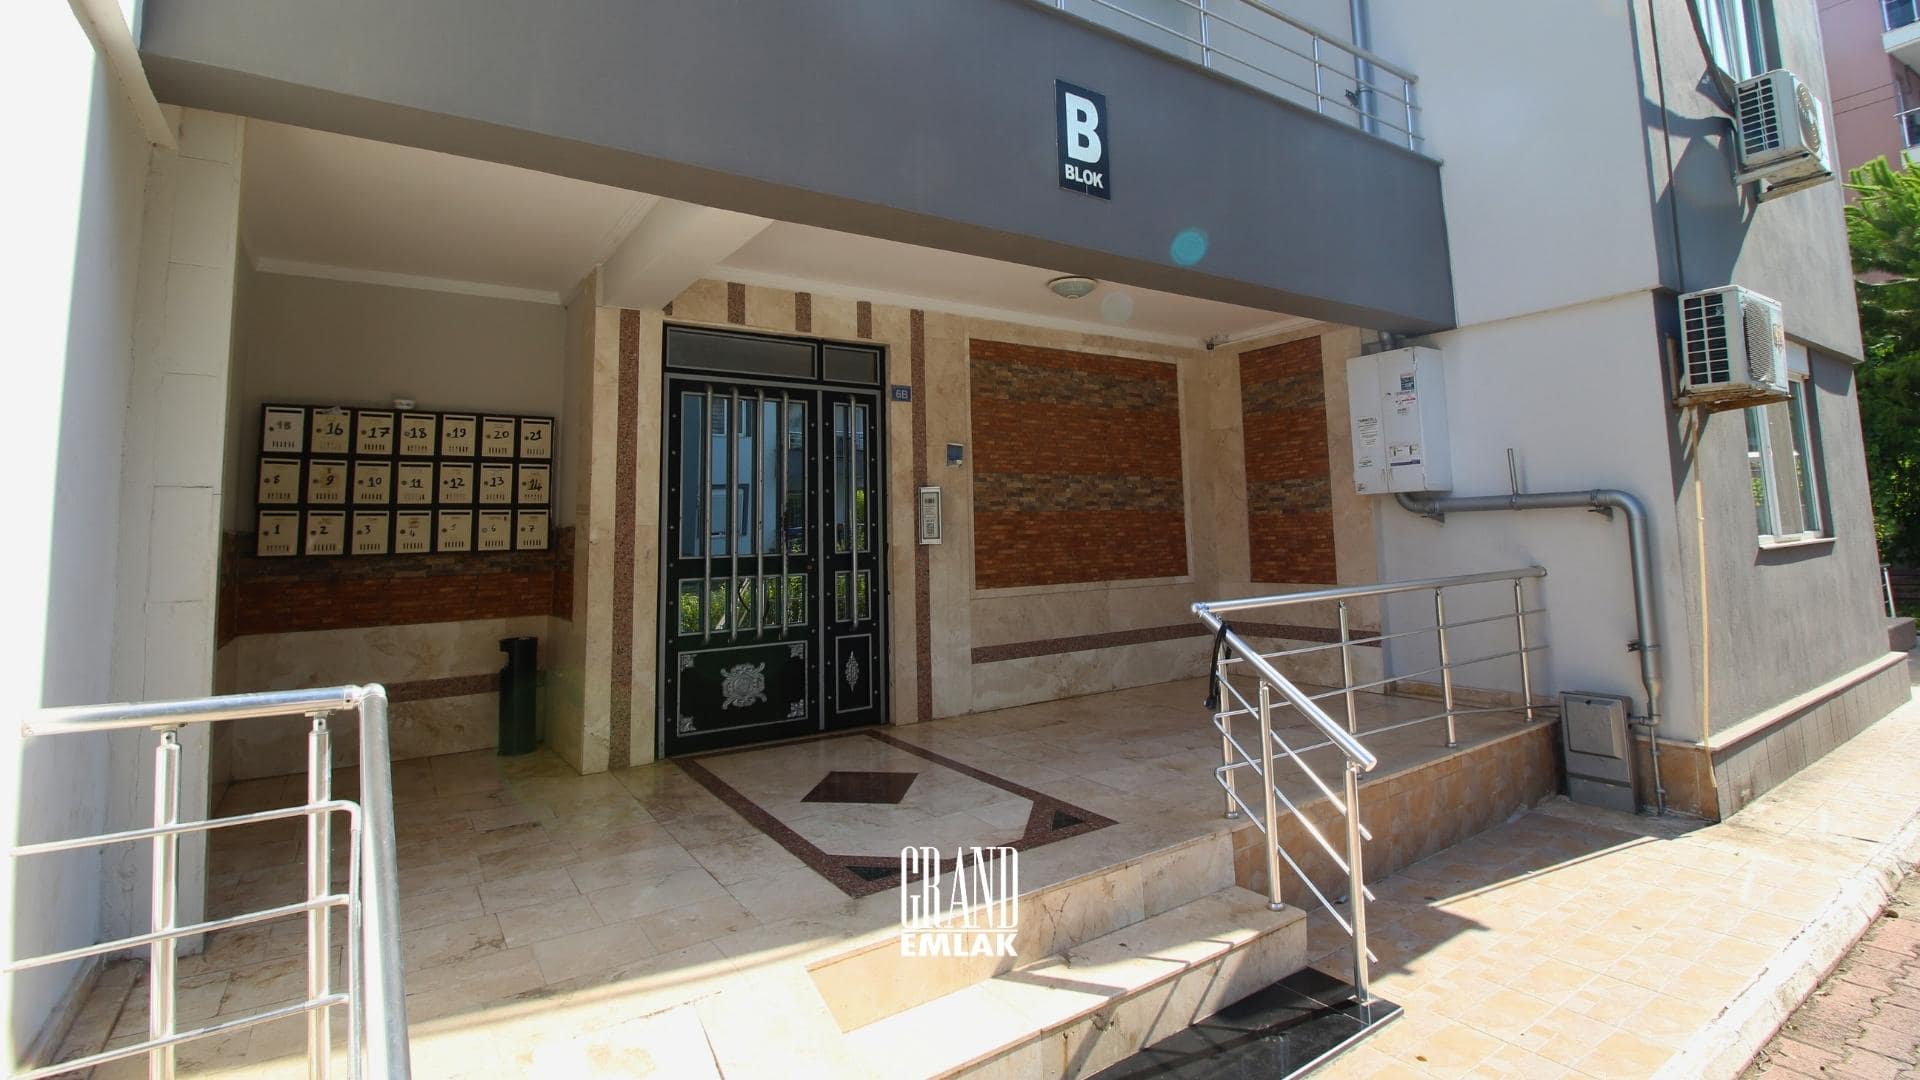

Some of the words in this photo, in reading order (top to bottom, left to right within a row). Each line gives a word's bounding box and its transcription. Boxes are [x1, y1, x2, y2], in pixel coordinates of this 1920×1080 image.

[1065, 92, 1101, 163] B
[1065, 163, 1104, 188] BLOK
[895, 389, 909, 399] 6B
[325, 422, 343, 436] 16
[368, 427, 390, 439] 17
[410, 427, 427, 439] 18
[450, 427, 466, 438] 19
[493, 430, 510, 440] 20
[529, 430, 542, 441] 21
[326, 475, 335, 486] 9
[368, 477, 382, 488] 10
[410, 478, 424, 489] 11
[449, 477, 465, 489] 12
[489, 476, 505, 488] 13
[528, 479, 543, 491] 14
[273, 524, 280, 535] 1
[320, 526, 328, 535] 2
[365, 525, 371, 534] 3
